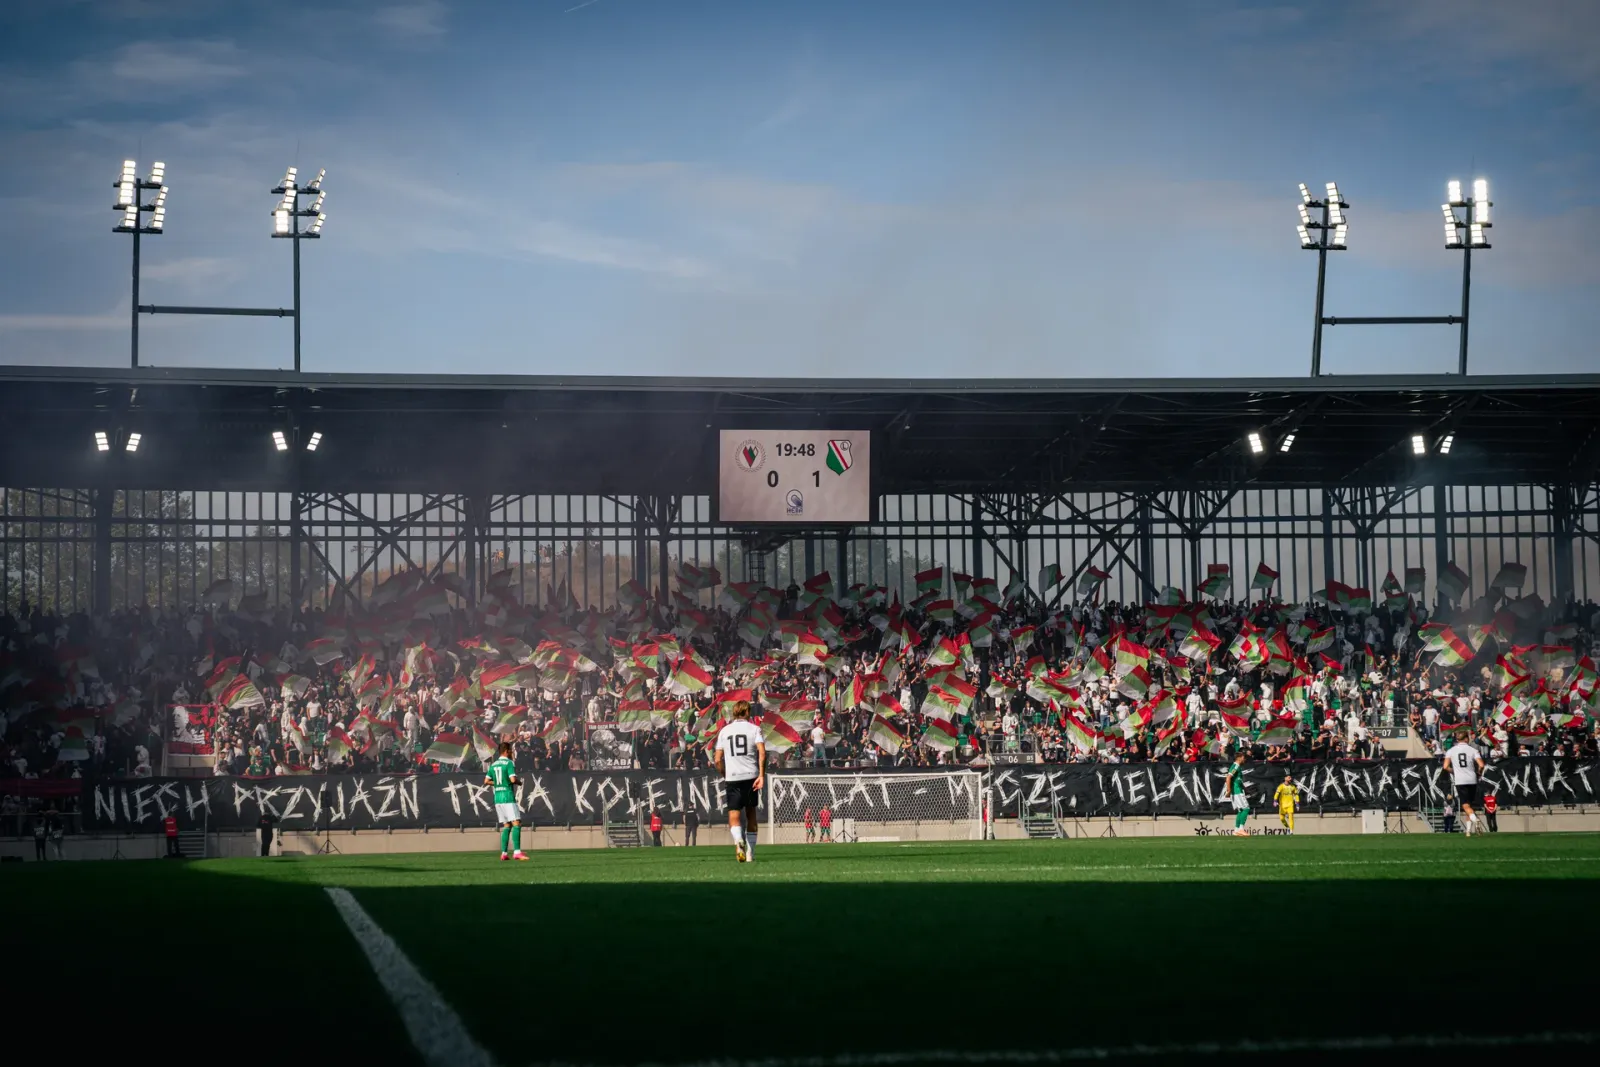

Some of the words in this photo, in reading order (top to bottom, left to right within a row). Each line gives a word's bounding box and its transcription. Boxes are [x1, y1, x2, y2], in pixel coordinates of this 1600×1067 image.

[776, 443, 815, 457] 19:48
[767, 470, 779, 487] 0
[812, 470, 820, 487] 1
[727, 734, 747, 757] 19
[1008, 755, 1019, 764] 06
[1458, 753, 1467, 768] 8
[94, 781, 212, 824] NIECH
[232, 775, 420, 823] PRZYJAŹŃ
